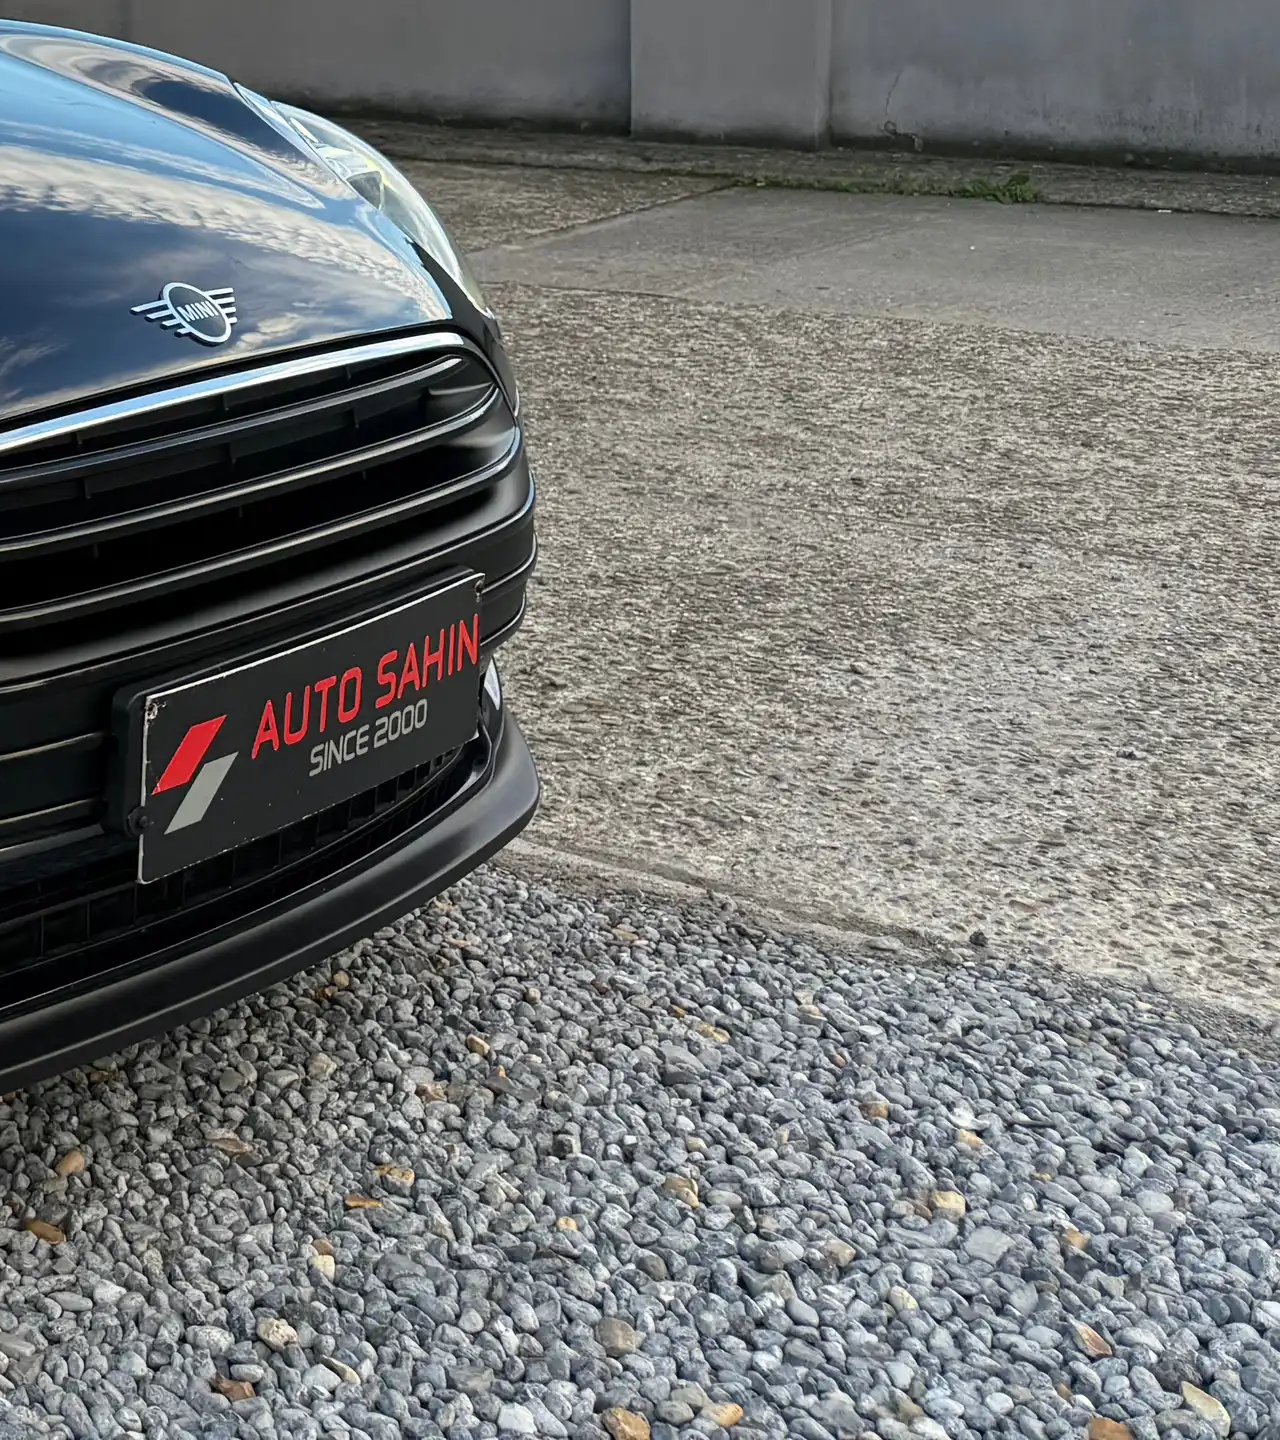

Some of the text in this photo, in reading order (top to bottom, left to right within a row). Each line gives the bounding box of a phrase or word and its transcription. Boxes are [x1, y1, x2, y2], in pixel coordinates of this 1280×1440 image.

[177, 300, 219, 322] MINI
[252, 614, 478, 759] AUTO SAHIN
[309, 699, 427, 776] SINCE 2000
